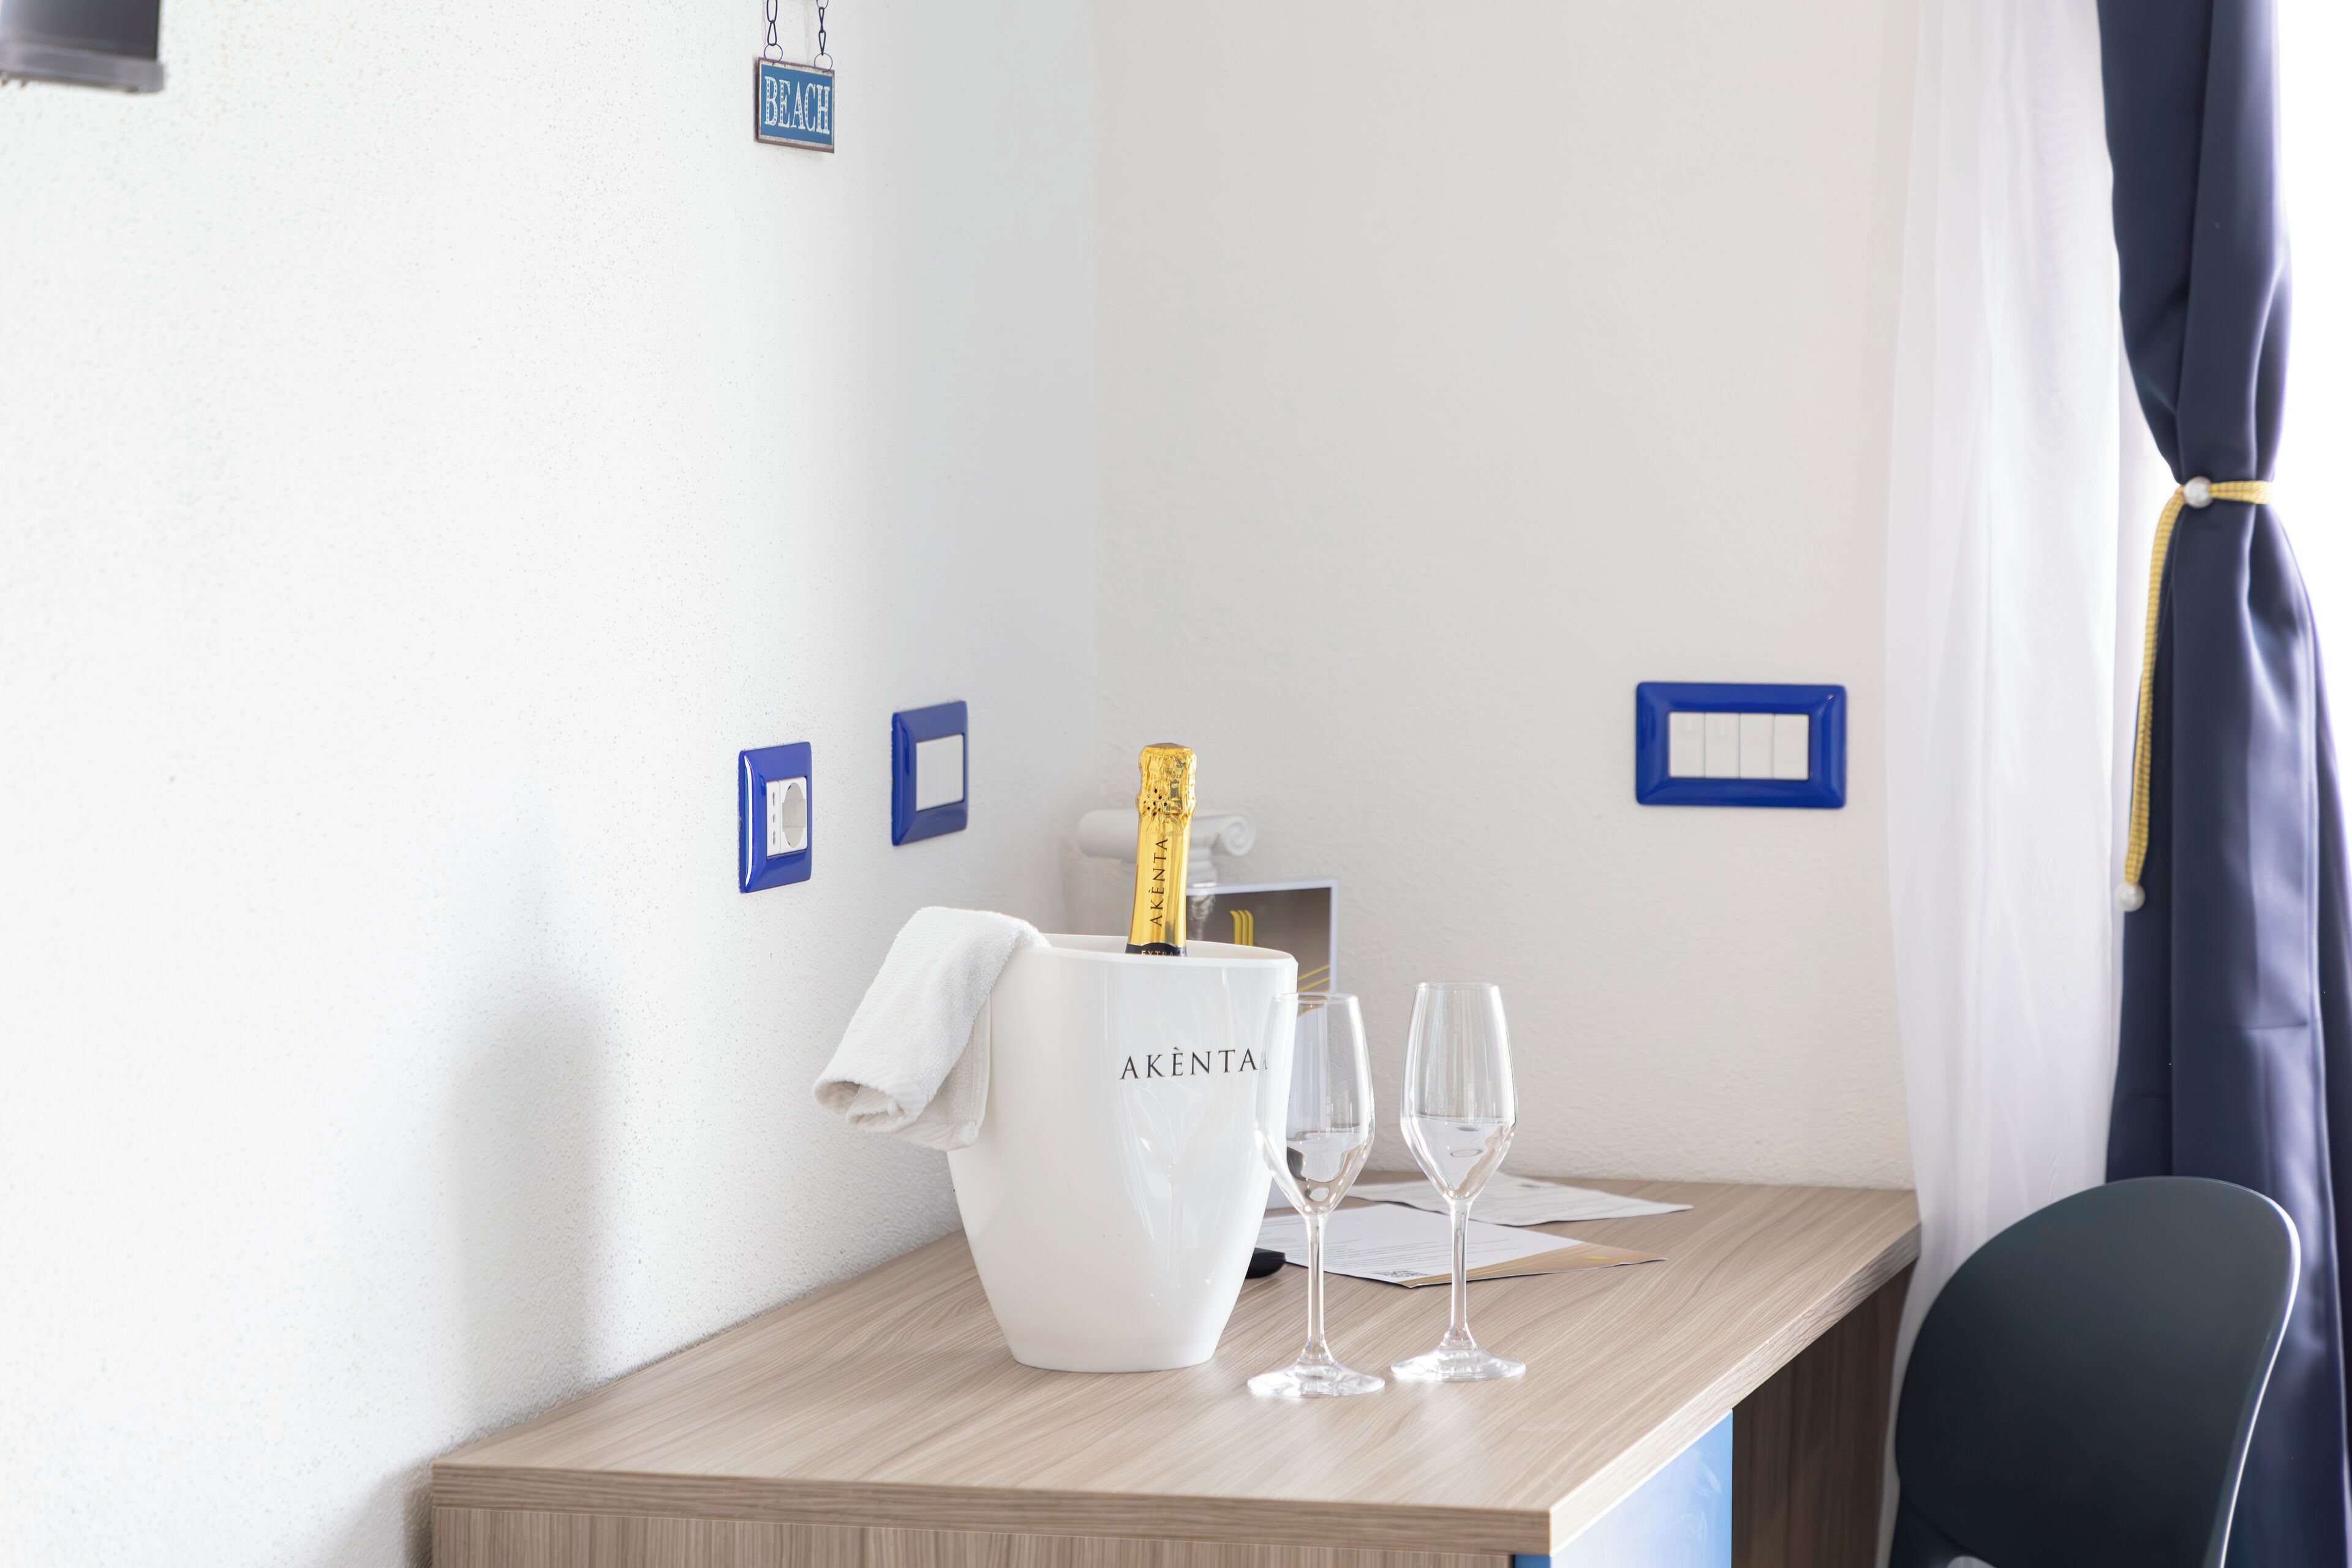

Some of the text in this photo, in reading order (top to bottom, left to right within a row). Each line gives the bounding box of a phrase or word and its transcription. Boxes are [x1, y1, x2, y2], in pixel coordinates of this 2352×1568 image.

[764, 75, 831, 135] BEACH
[1148, 838, 1168, 927] AKÈNTA
[1119, 1046, 1258, 1080] AKÈNTA
